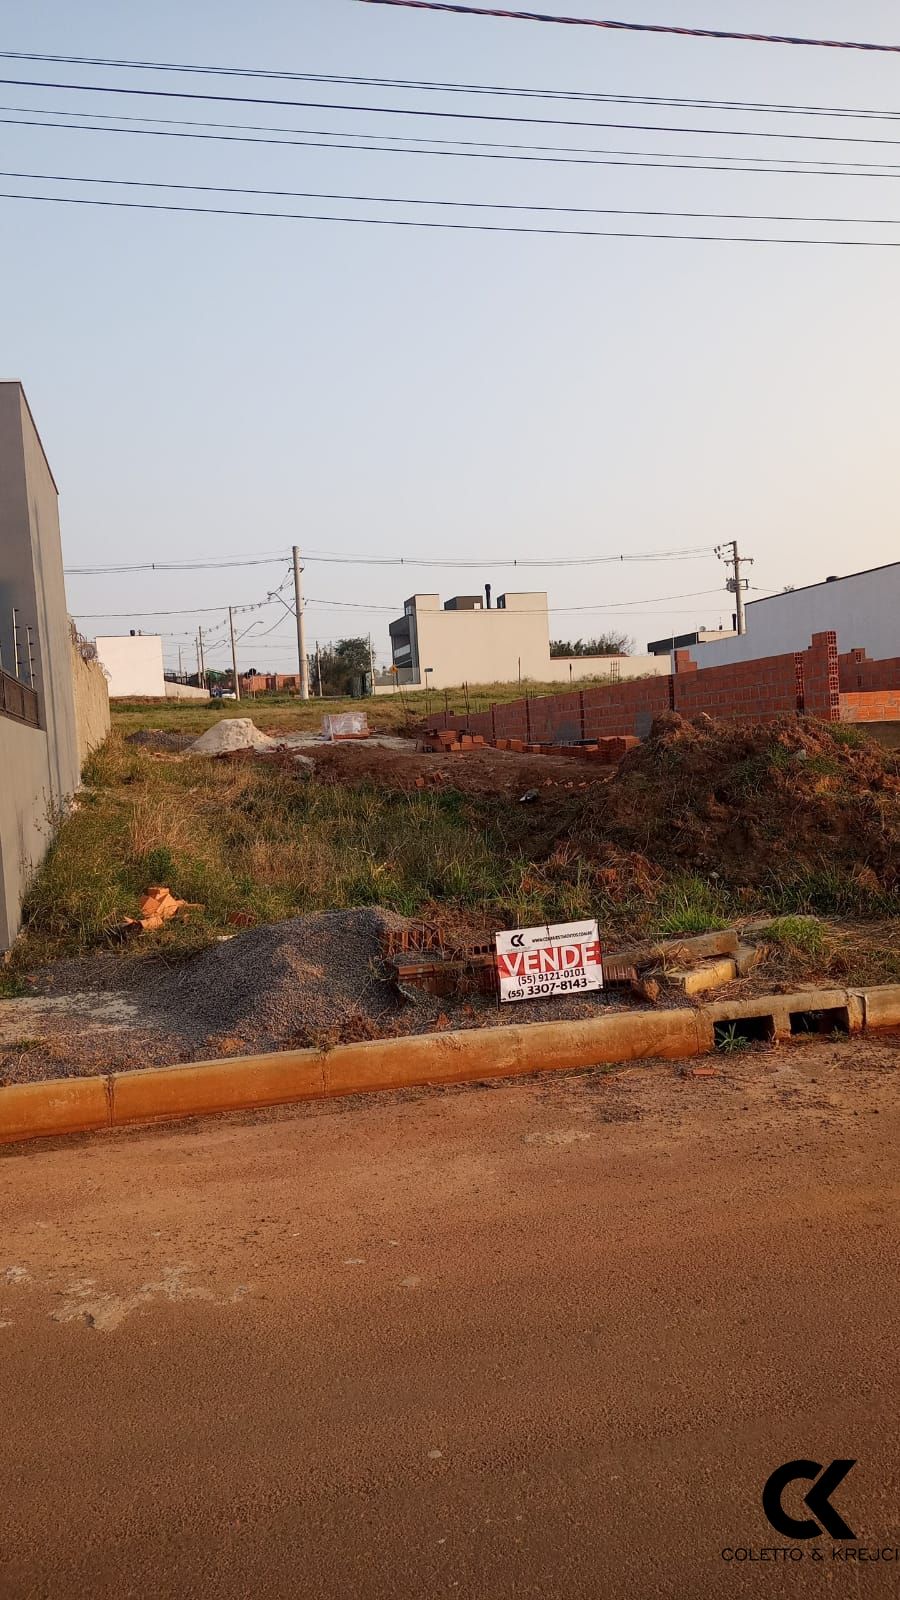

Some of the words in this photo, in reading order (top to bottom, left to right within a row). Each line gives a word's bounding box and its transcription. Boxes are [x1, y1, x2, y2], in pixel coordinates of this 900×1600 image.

[511, 934, 525, 947] CK
[502, 941, 597, 977] VENDE
[518, 975, 536, 986] (55)
[538, 968, 586, 982] 9121-0101
[508, 990, 524, 999] (55)
[527, 978, 587, 995] 3307-8143
